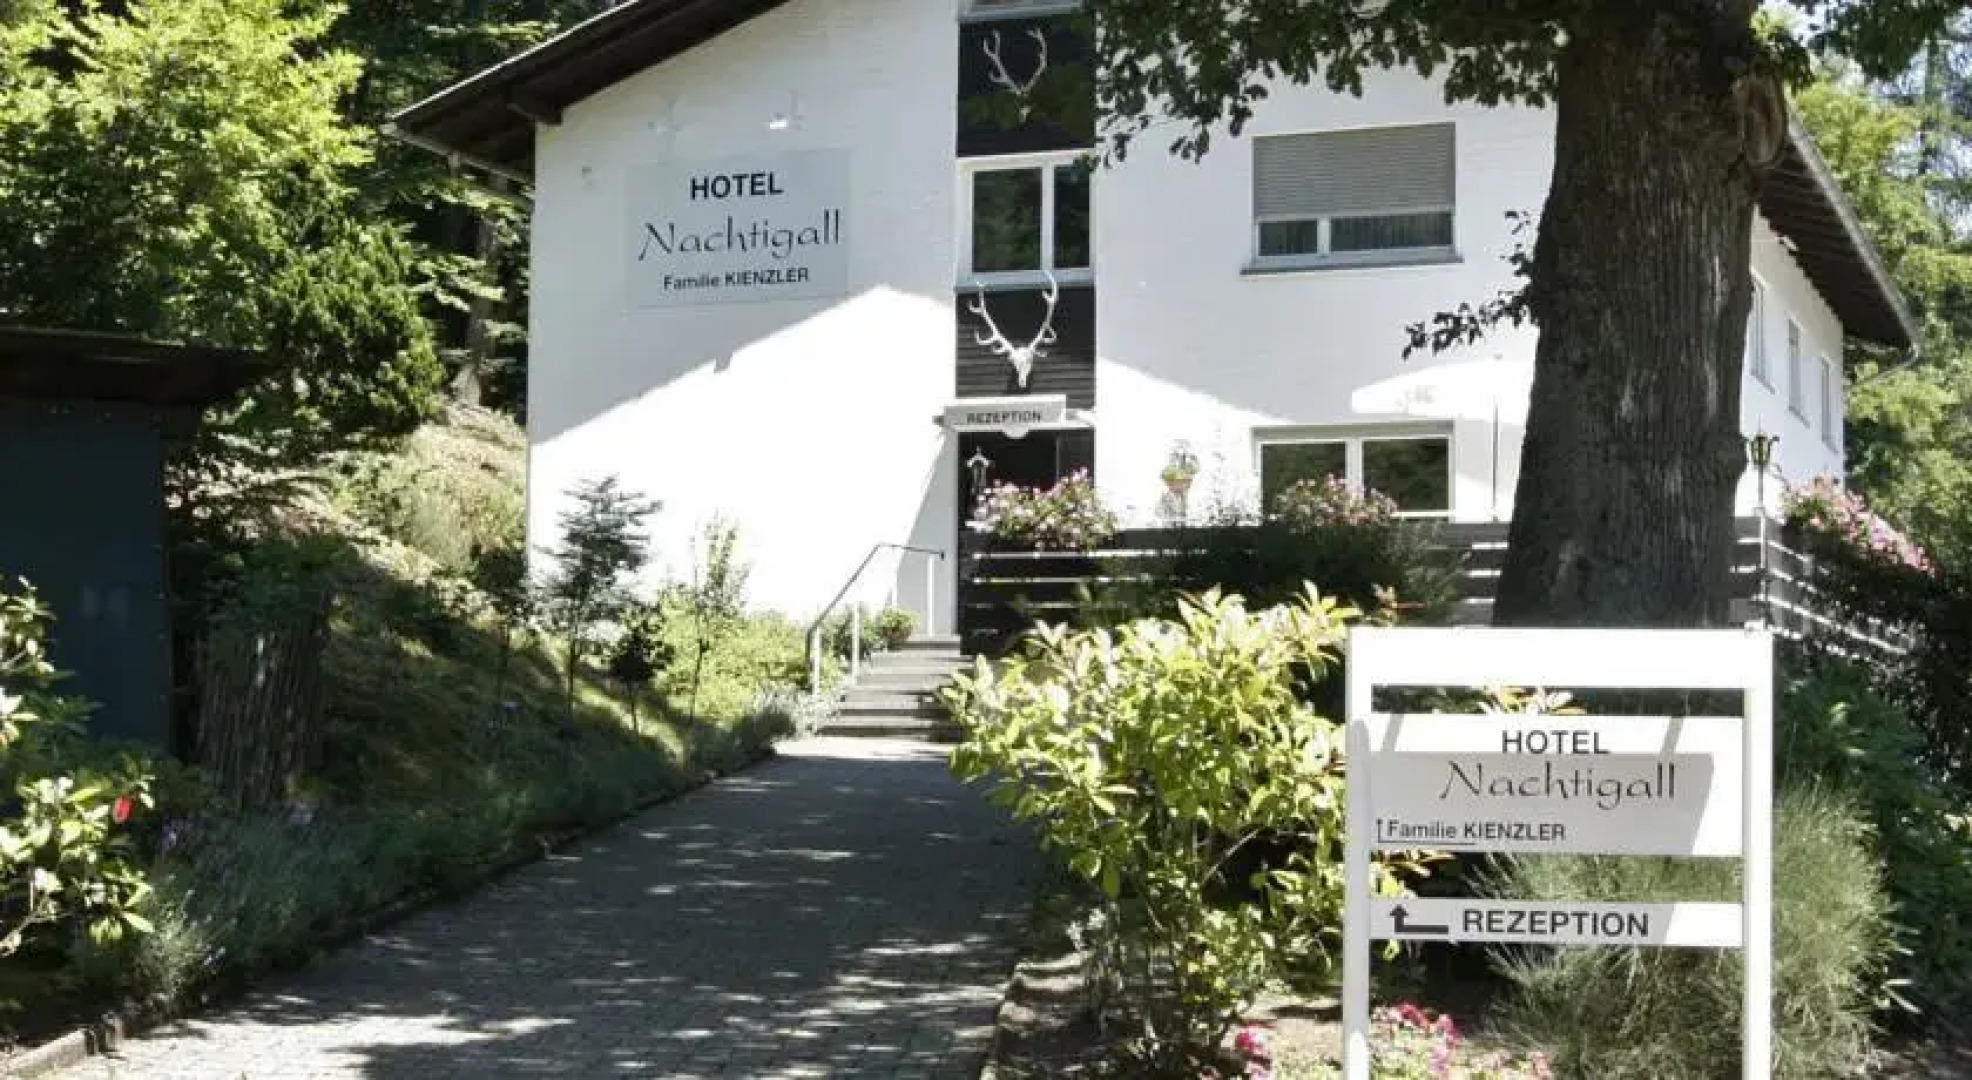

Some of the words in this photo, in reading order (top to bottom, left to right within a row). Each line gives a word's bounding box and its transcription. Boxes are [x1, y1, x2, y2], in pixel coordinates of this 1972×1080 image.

[690, 171, 784, 200] HOTEL
[638, 208, 841, 261] Nachtigall
[663, 273, 721, 291] Familie
[724, 266, 810, 287] KIENZLER
[966, 410, 1042, 424] REZEPTION
[1502, 730, 1610, 755] HOTEL
[1439, 760, 1676, 810] Nachtigall
[1387, 819, 1457, 839] Familie
[1463, 822, 1567, 842] KIENZLER
[1462, 909, 1650, 938] REZEPTION
